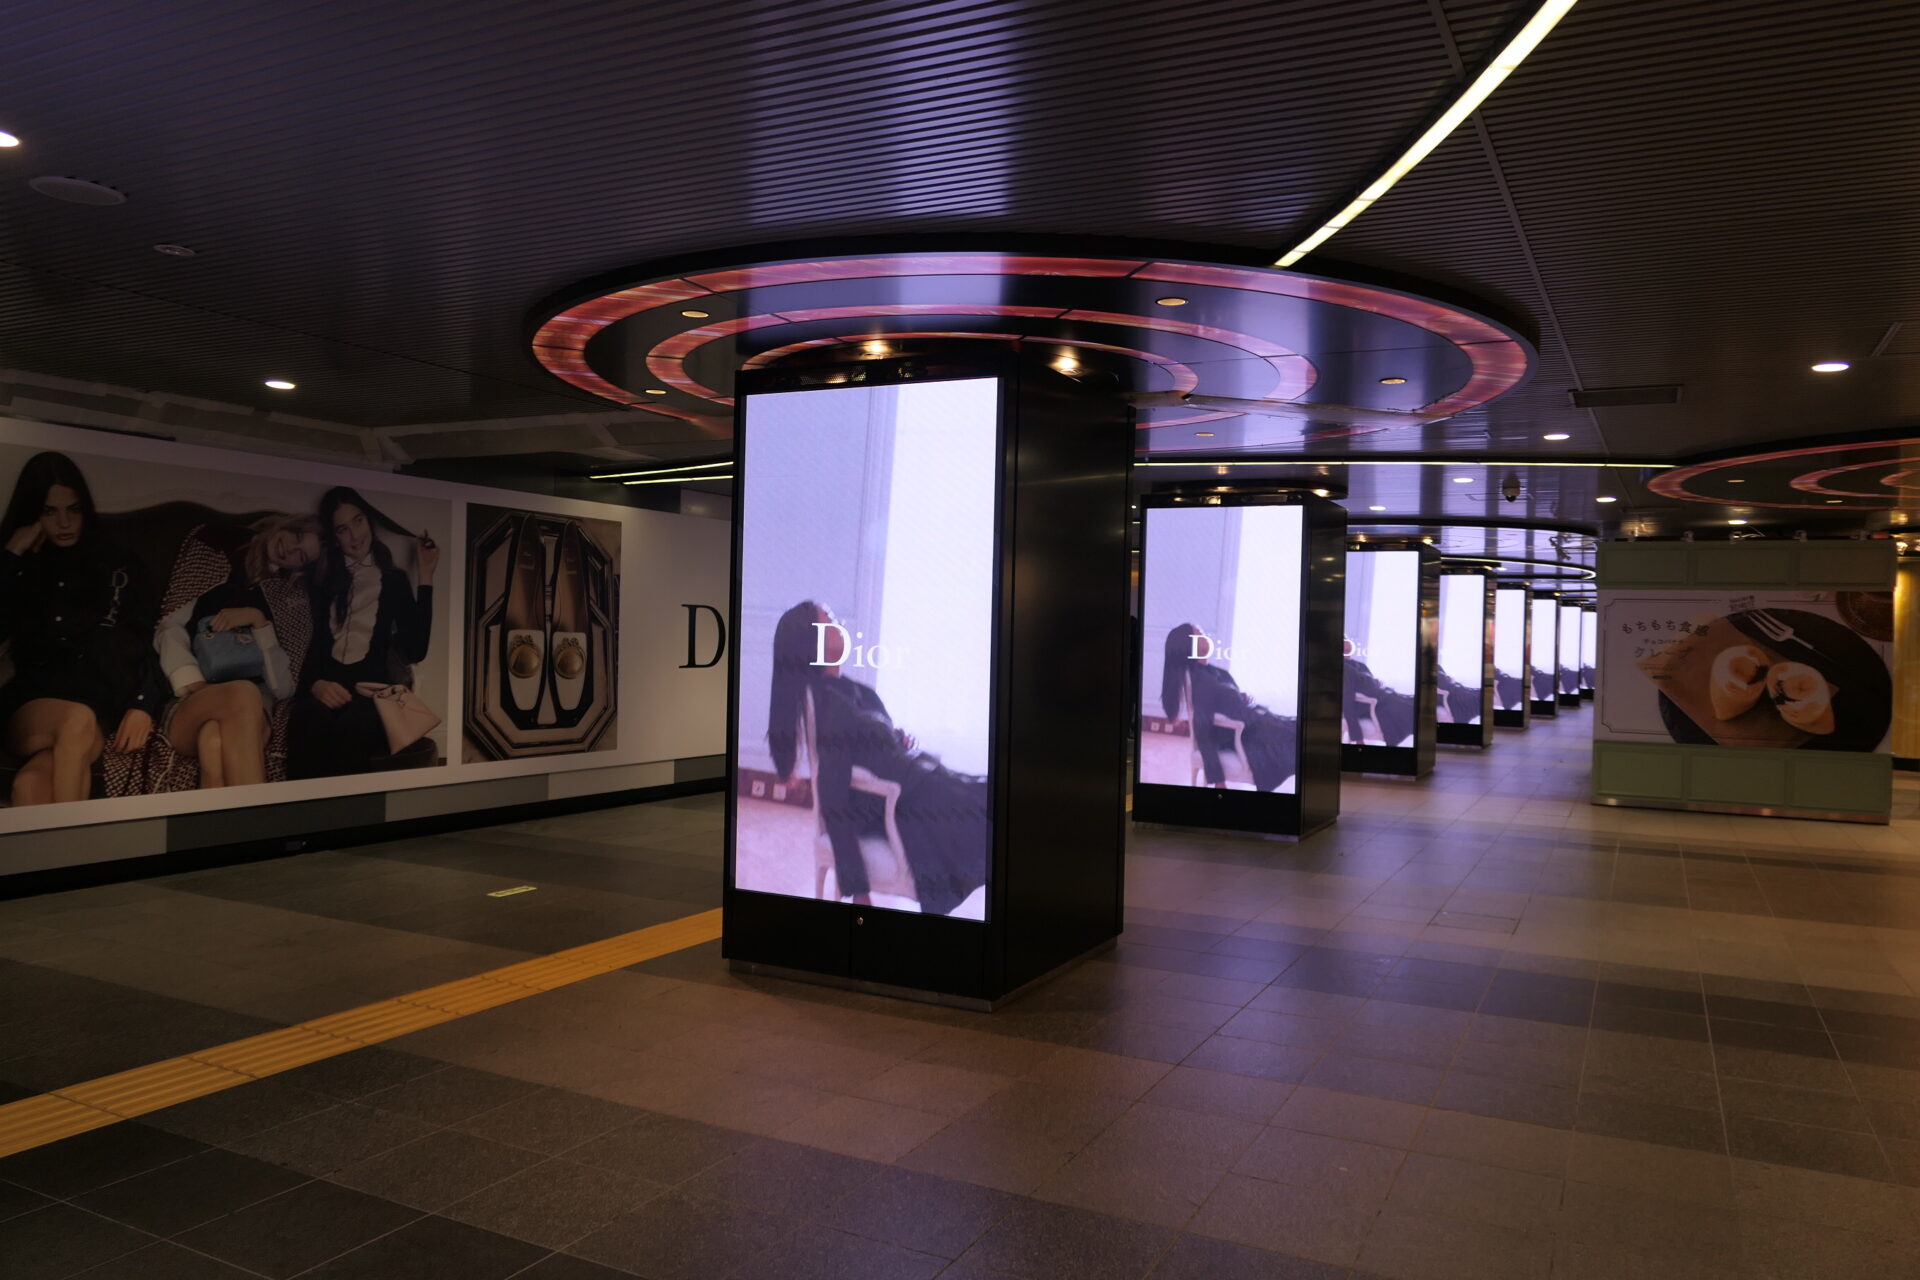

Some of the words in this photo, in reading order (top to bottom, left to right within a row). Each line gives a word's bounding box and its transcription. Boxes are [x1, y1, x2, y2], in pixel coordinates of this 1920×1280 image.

[1622, 620, 1710, 637] もちもち食感
[810, 623, 912, 669] Dior
[1188, 634, 1249, 661] Dior
